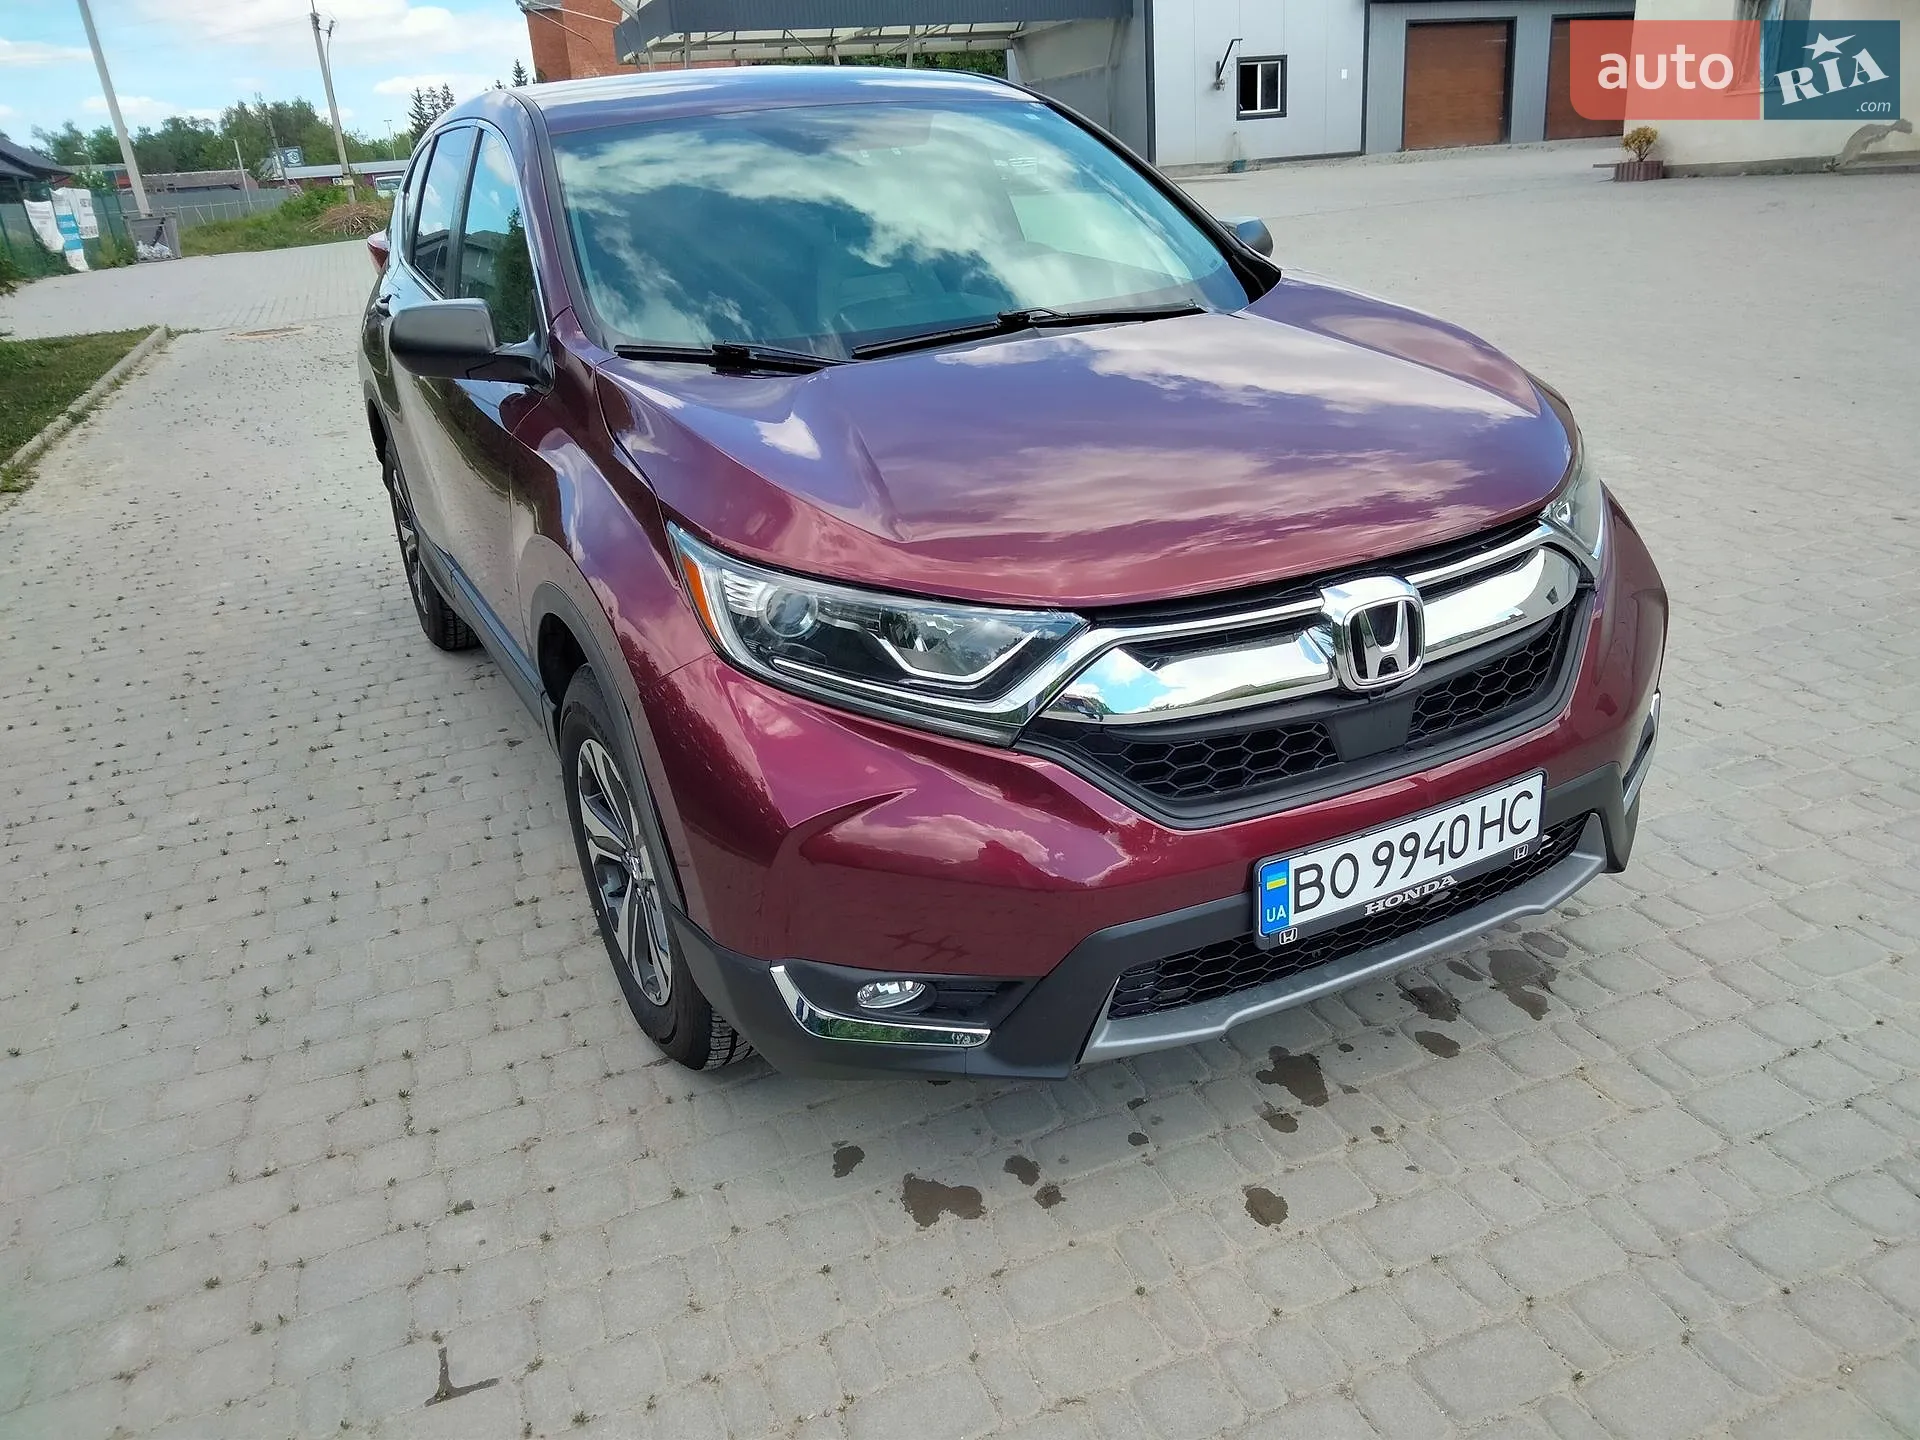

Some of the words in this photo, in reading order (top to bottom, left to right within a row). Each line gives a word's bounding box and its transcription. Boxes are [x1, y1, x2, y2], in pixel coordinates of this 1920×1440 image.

[1372, 814, 1469, 889] 9940
[1266, 904, 1286, 923] UA
[1364, 875, 1458, 916] HONDA
